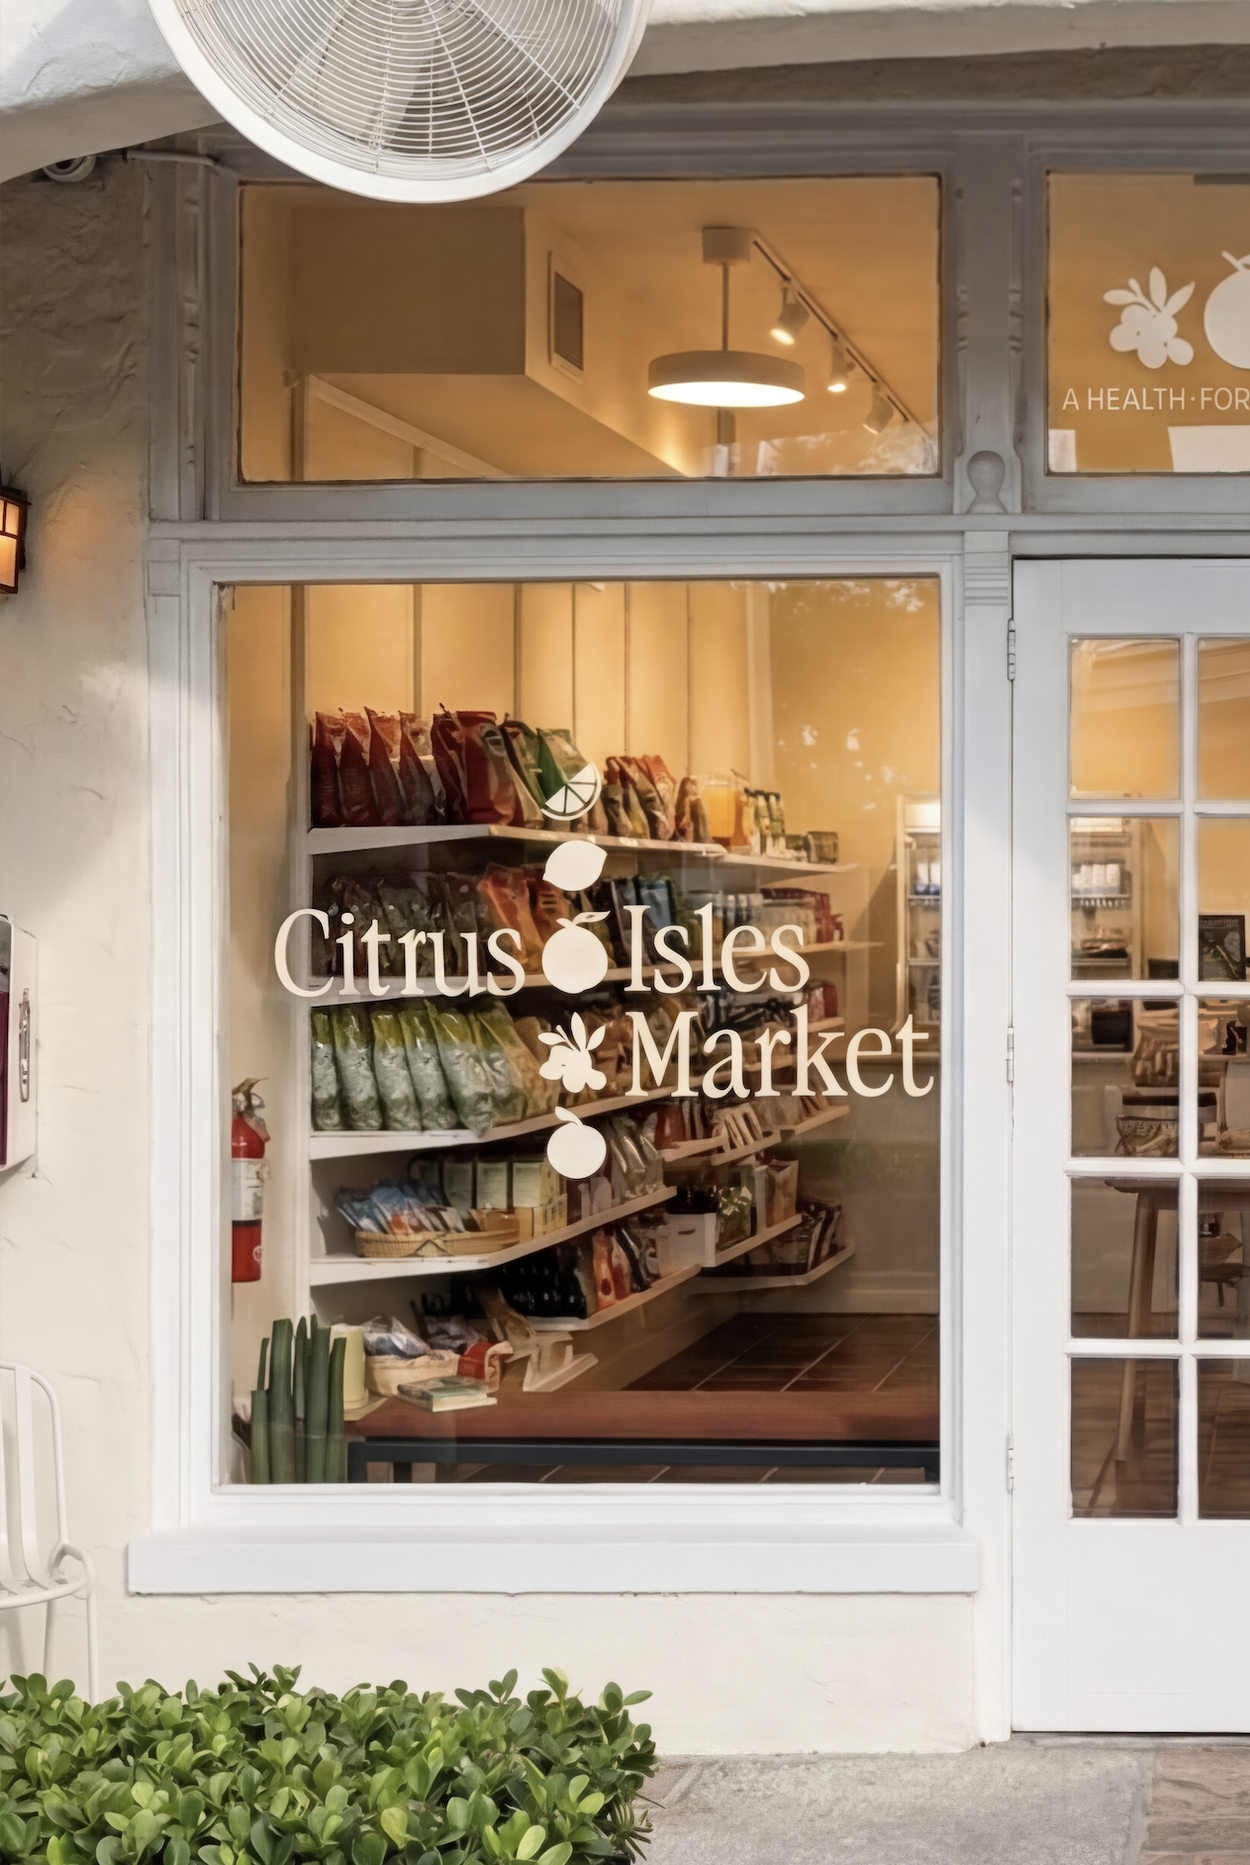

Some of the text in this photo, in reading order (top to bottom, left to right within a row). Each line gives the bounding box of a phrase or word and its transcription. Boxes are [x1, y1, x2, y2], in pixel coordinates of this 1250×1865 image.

[1062, 387, 1080, 411] A
[274, 902, 811, 998] Citrus Isles
[624, 1004, 936, 1098] Market
